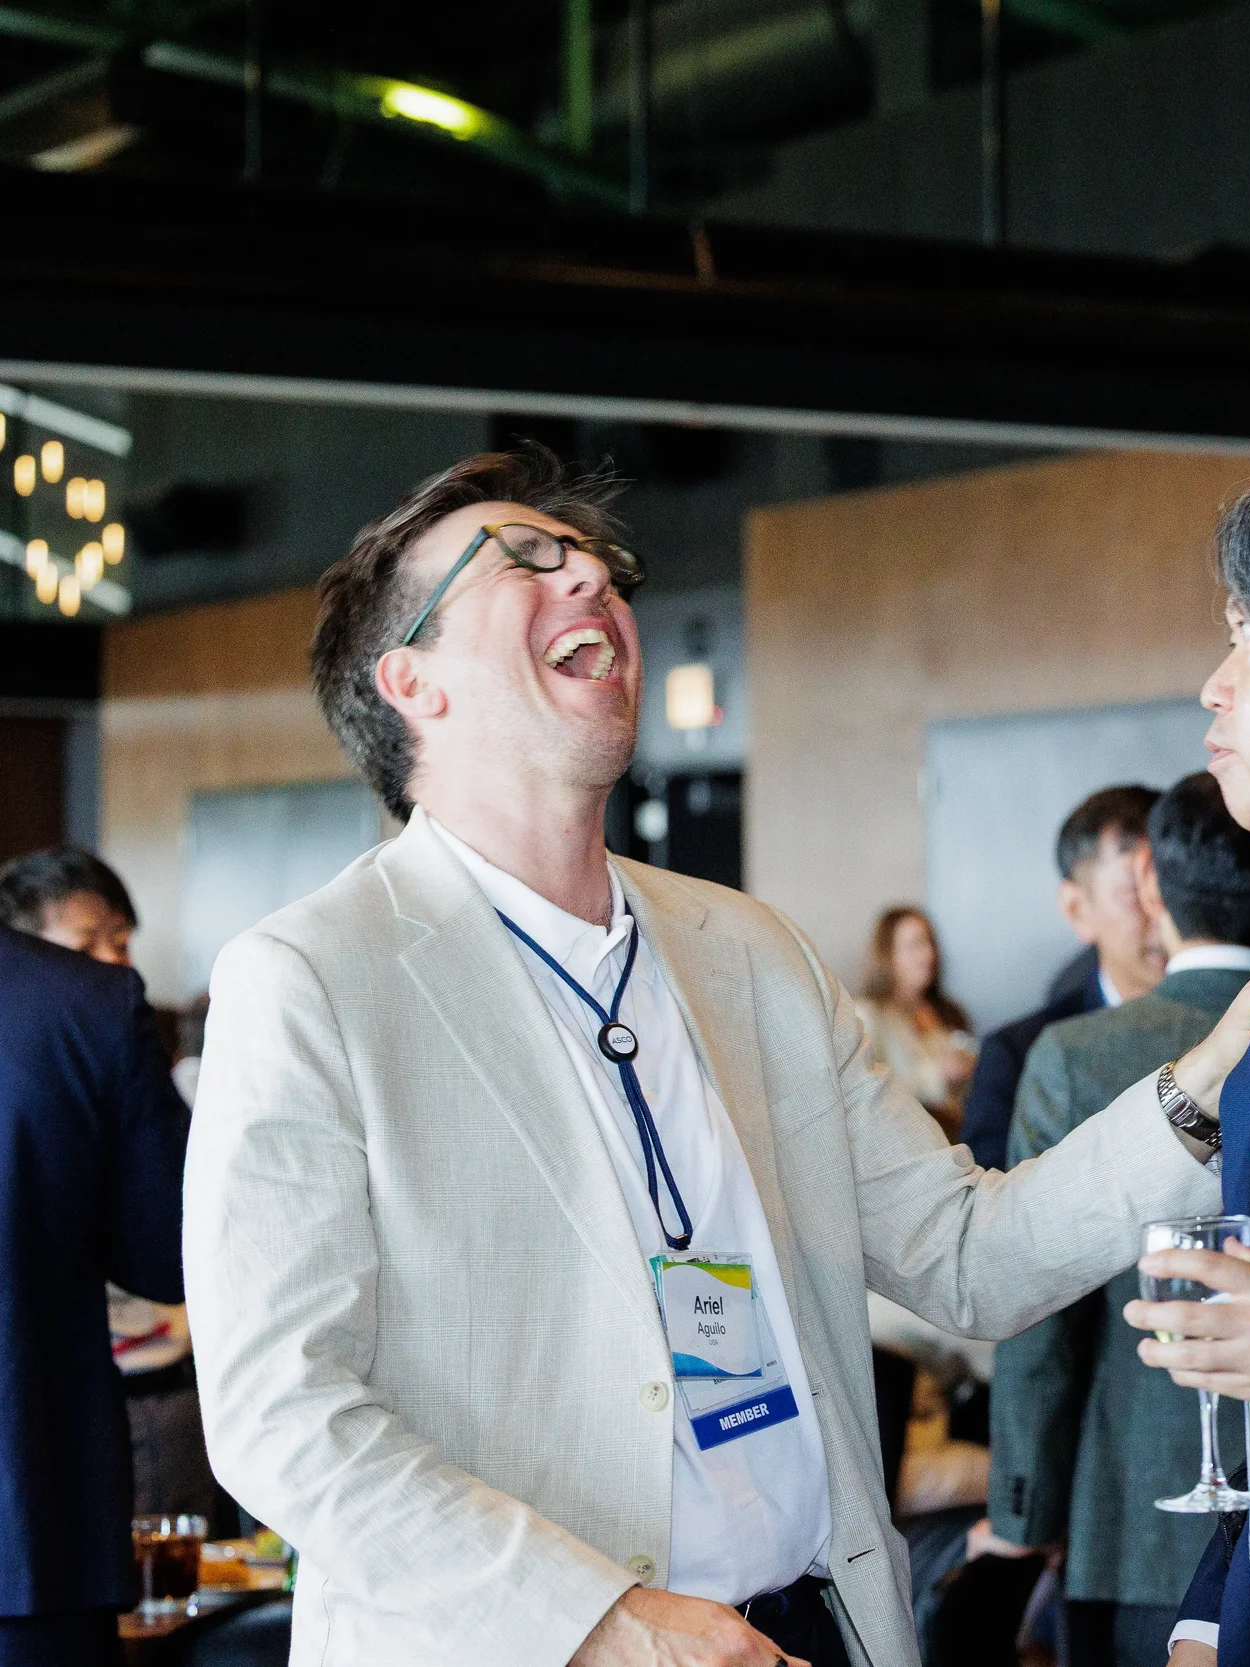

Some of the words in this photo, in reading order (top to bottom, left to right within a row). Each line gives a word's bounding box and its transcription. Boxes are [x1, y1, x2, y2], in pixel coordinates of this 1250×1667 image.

[612, 1035, 633, 1044] ASCO
[694, 1296, 724, 1315] Ariel
[697, 1321, 726, 1338] Aguilo
[719, 1402, 770, 1431] MEMBER
